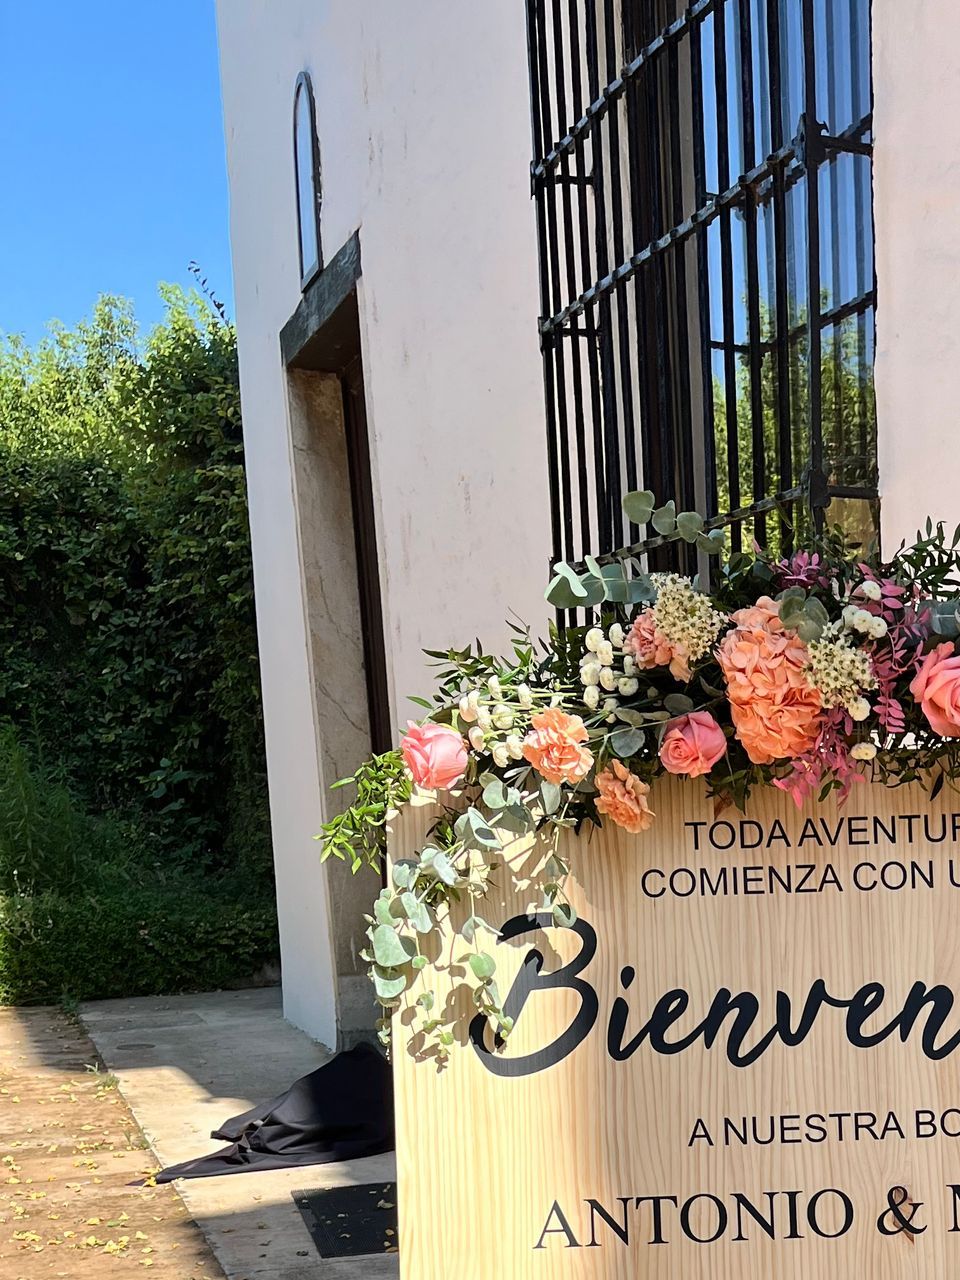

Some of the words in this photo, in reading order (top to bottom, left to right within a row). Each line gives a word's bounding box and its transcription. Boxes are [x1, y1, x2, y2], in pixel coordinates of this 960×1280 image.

[684, 818, 791, 851] TODA
[640, 864, 844, 899] COMIENZA
[852, 859, 932, 892] CON
[687, 1118, 714, 1147] A
[723, 1111, 906, 1145] NUESTRA
[532, 1187, 855, 1250] ANTONIO
[876, 1185, 929, 1236] &
